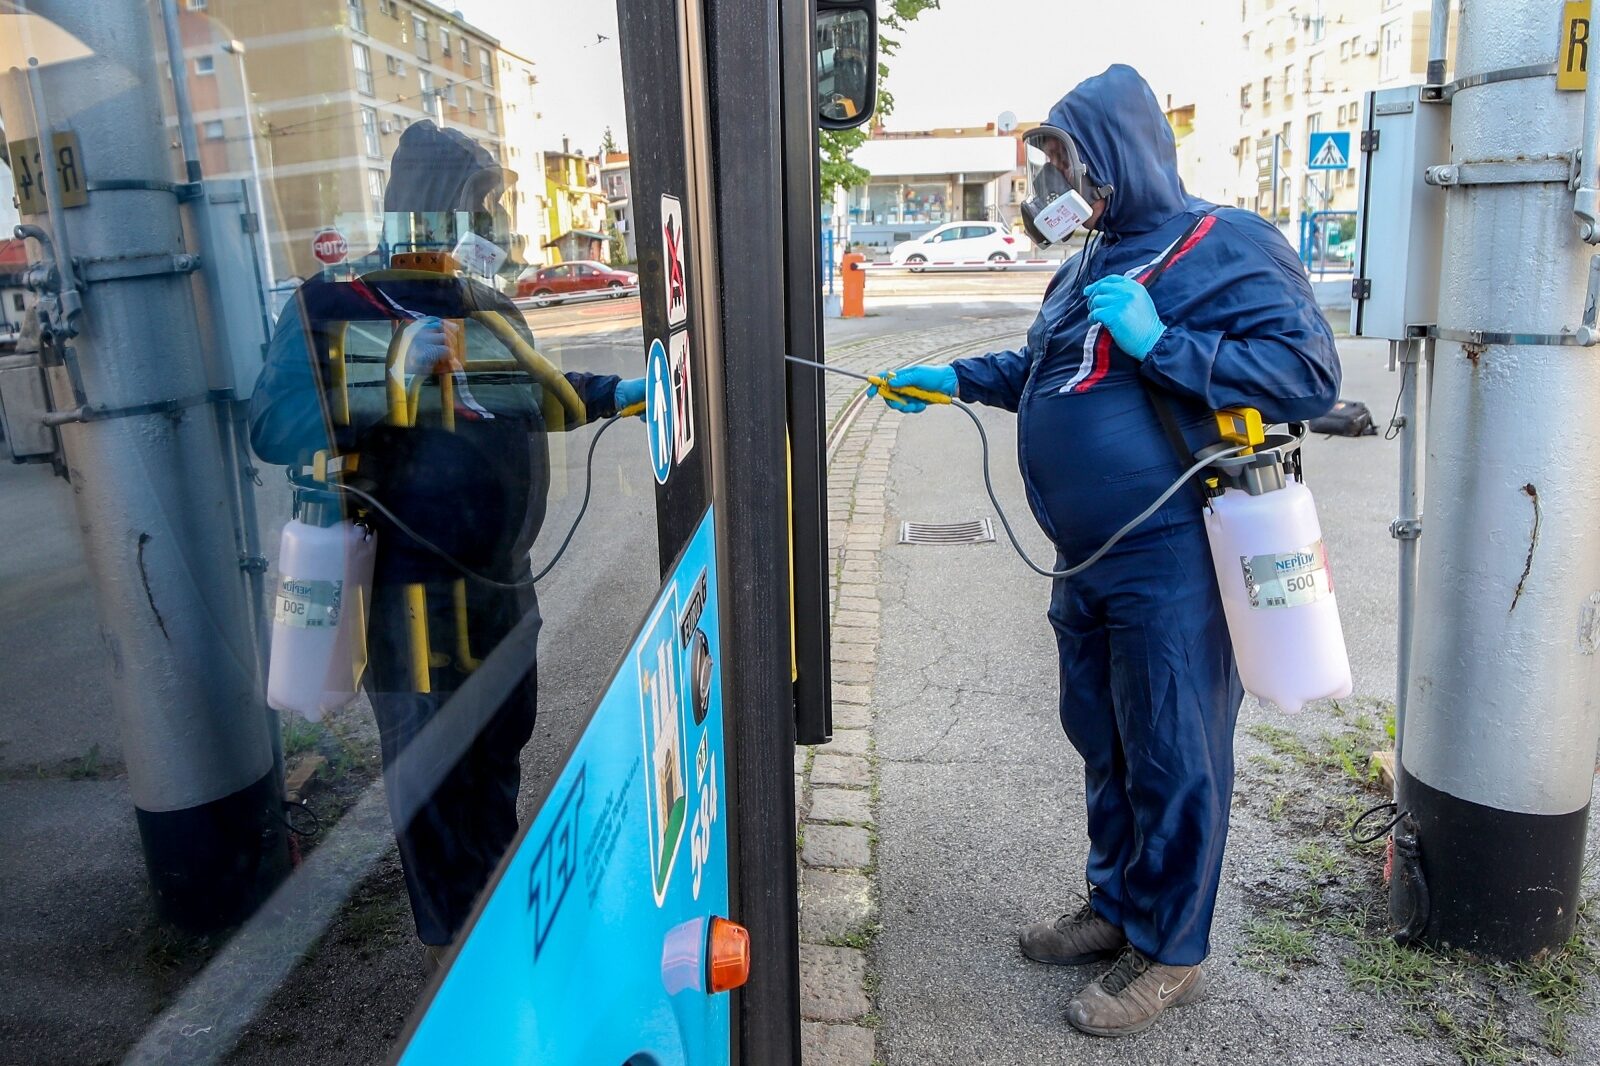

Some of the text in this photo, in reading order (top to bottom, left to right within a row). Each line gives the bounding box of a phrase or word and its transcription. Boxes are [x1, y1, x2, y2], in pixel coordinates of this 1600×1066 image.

[1567, 18, 1590, 72] R
[1275, 552, 1315, 570] NEPTUN
[1286, 574, 1315, 592] 500
[683, 593, 702, 646] EURO
[691, 750, 718, 901] 584
